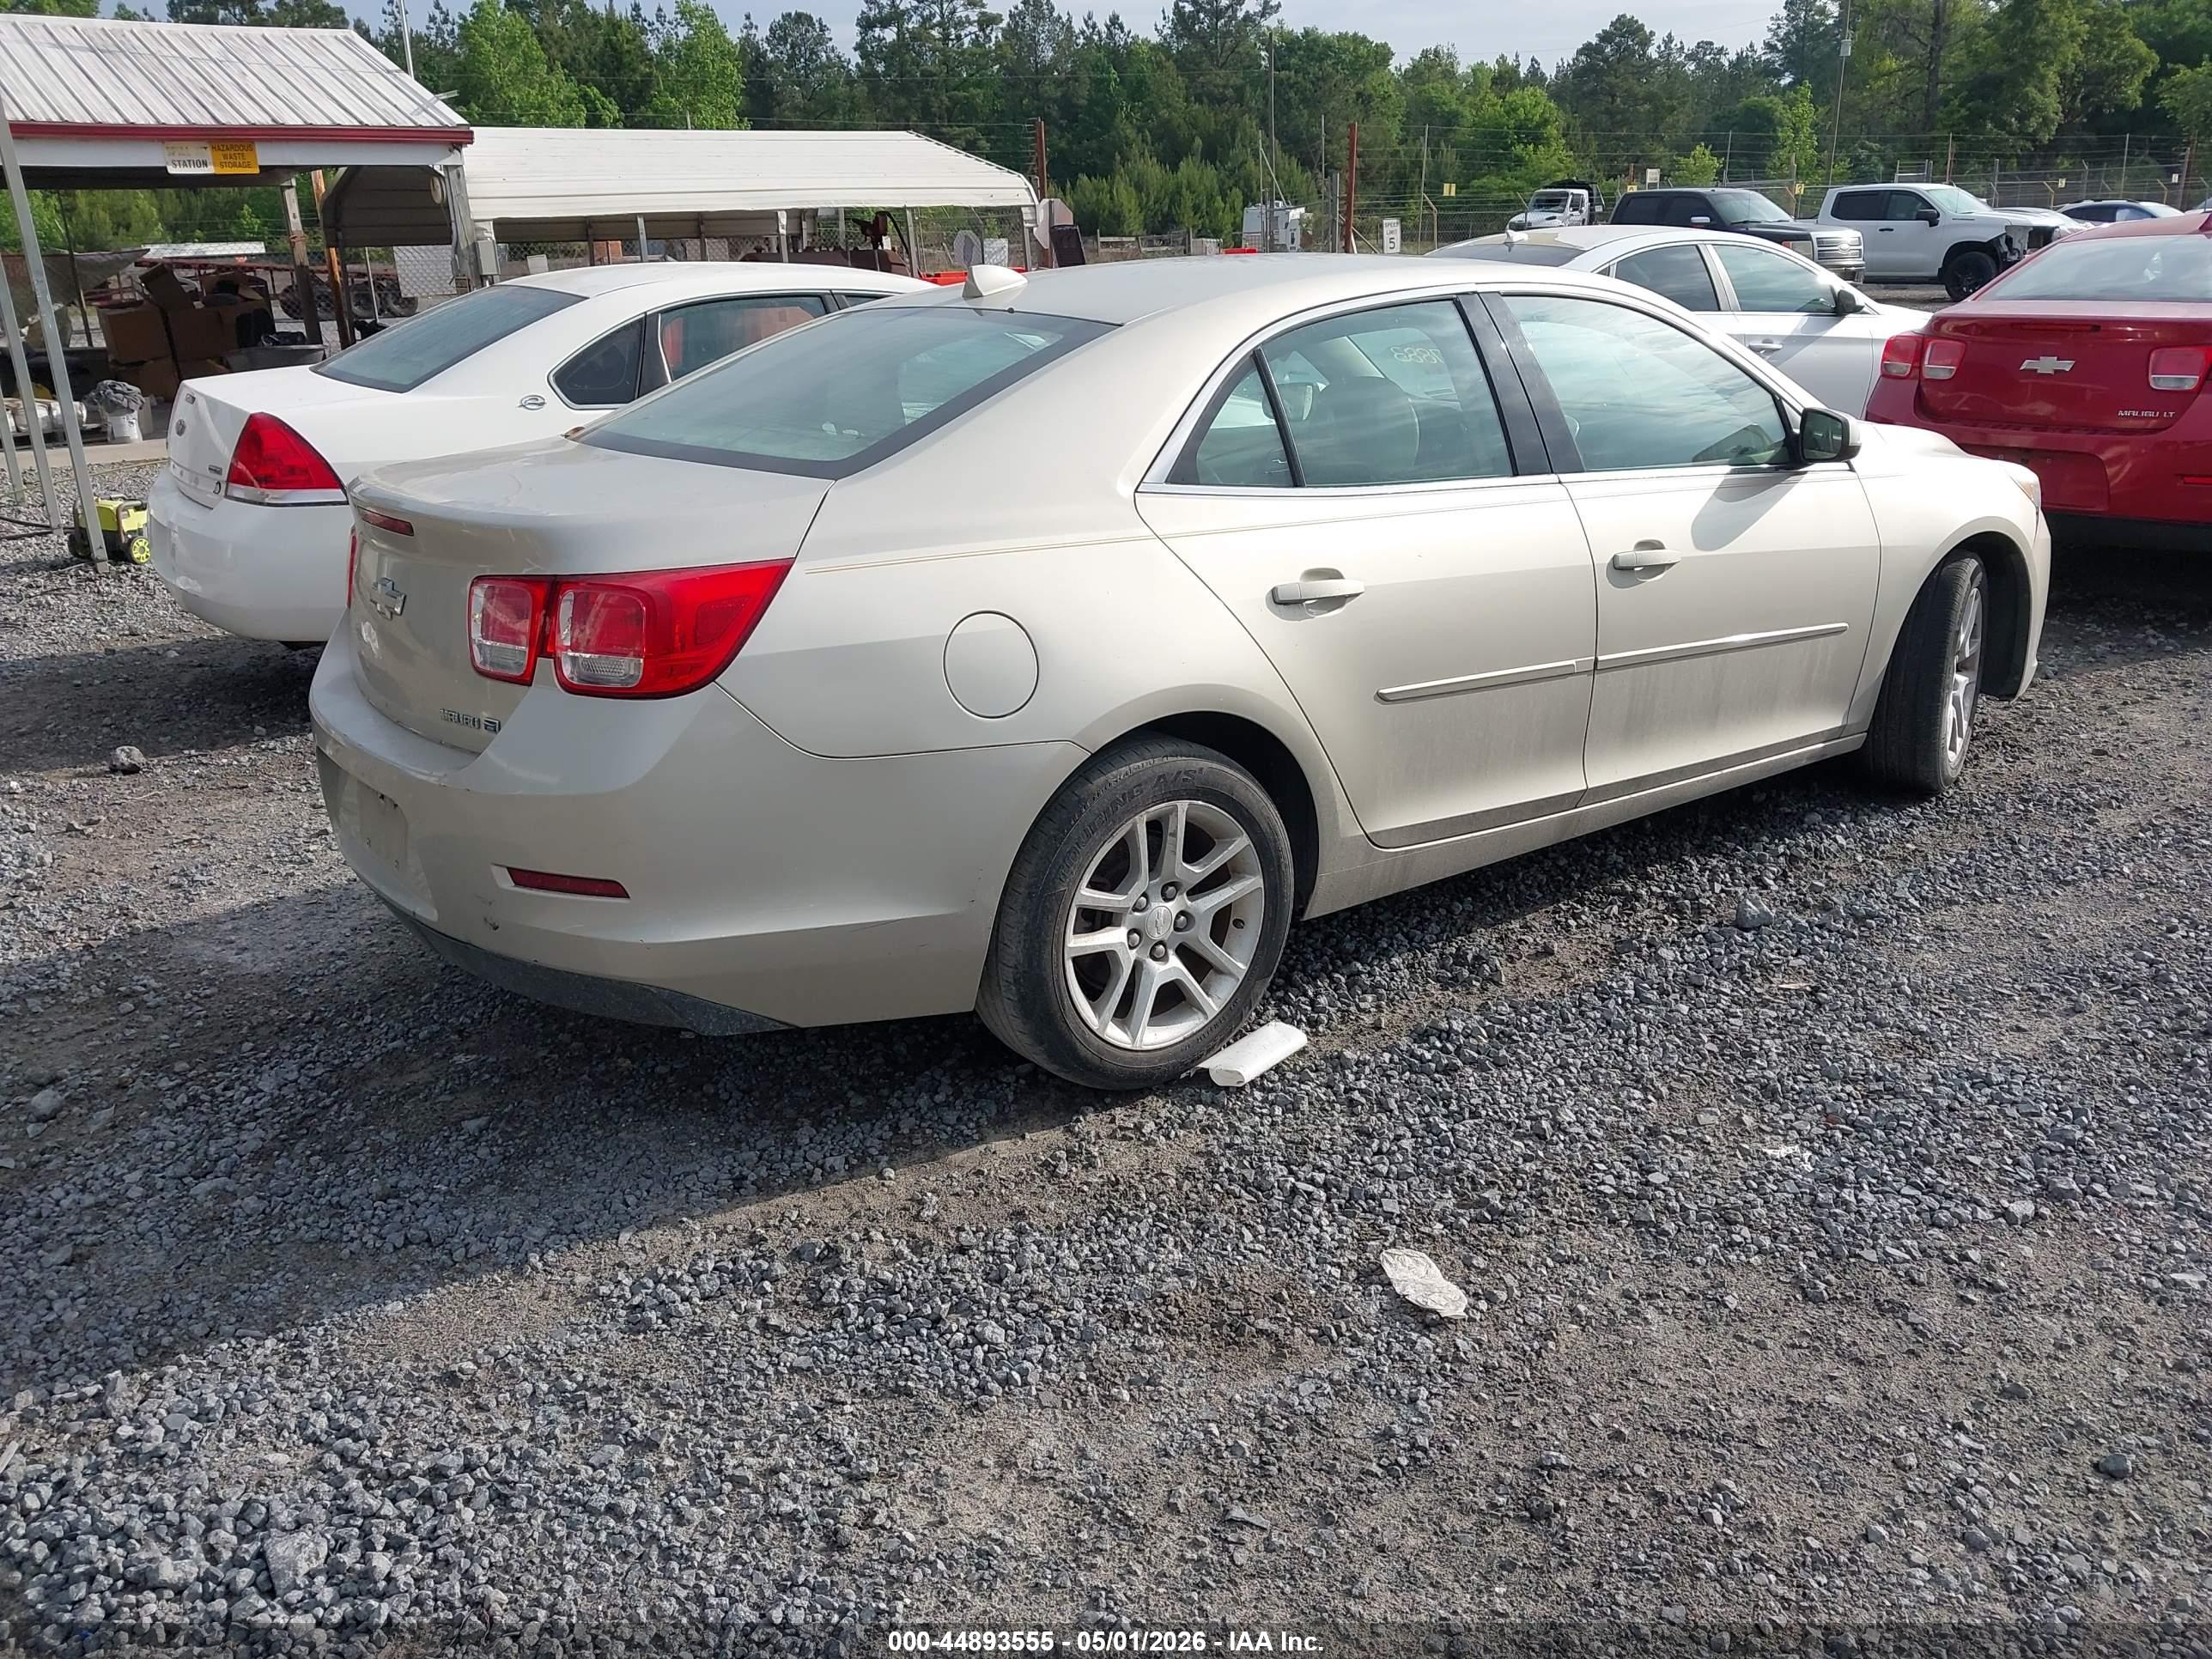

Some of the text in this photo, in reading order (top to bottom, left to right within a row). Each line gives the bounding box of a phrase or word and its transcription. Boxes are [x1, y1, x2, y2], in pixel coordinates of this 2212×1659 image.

[211, 143, 254, 152] HAZARDOUS
[171, 160, 209, 168] STATION
[220, 161, 252, 169] STORAGE
[1389, 237, 1395, 249] 5
